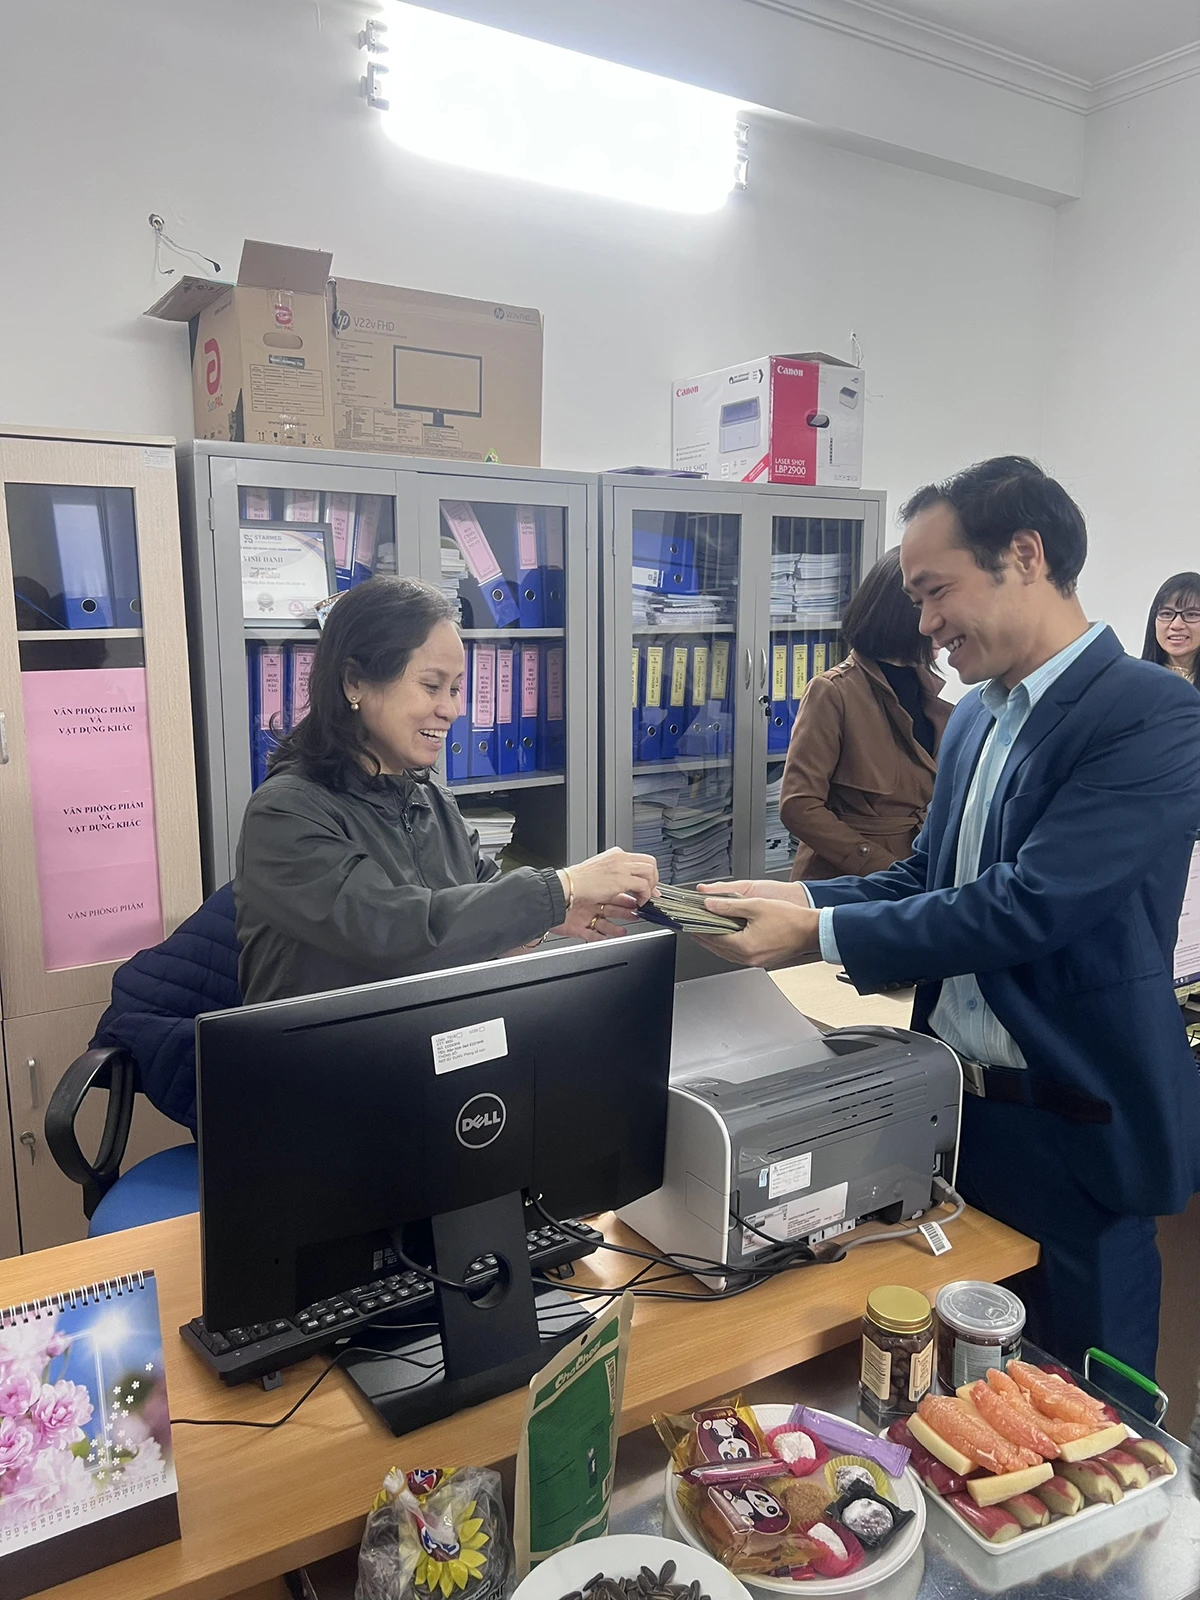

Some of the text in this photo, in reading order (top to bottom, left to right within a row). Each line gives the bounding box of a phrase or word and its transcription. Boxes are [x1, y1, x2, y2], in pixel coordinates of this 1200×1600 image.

[377, 320, 395, 331] FHD
[776, 365, 804, 377] Canon
[676, 385, 699, 397] Canon
[53, 707, 73, 716] VĂN
[75, 706, 108, 715] PHÒNG
[89, 715, 102, 723] VÀ
[79, 725, 106, 735] DỤNG
[107, 723, 133, 732] KHÁC
[63, 806, 82, 815] VĂN
[84, 804, 117, 813] PHÒNG
[98, 812, 111, 821] VÀ
[89, 822, 115, 832] DỤNG
[116, 819, 142, 829] KHÁC
[462, 1110, 501, 1133] DELL
